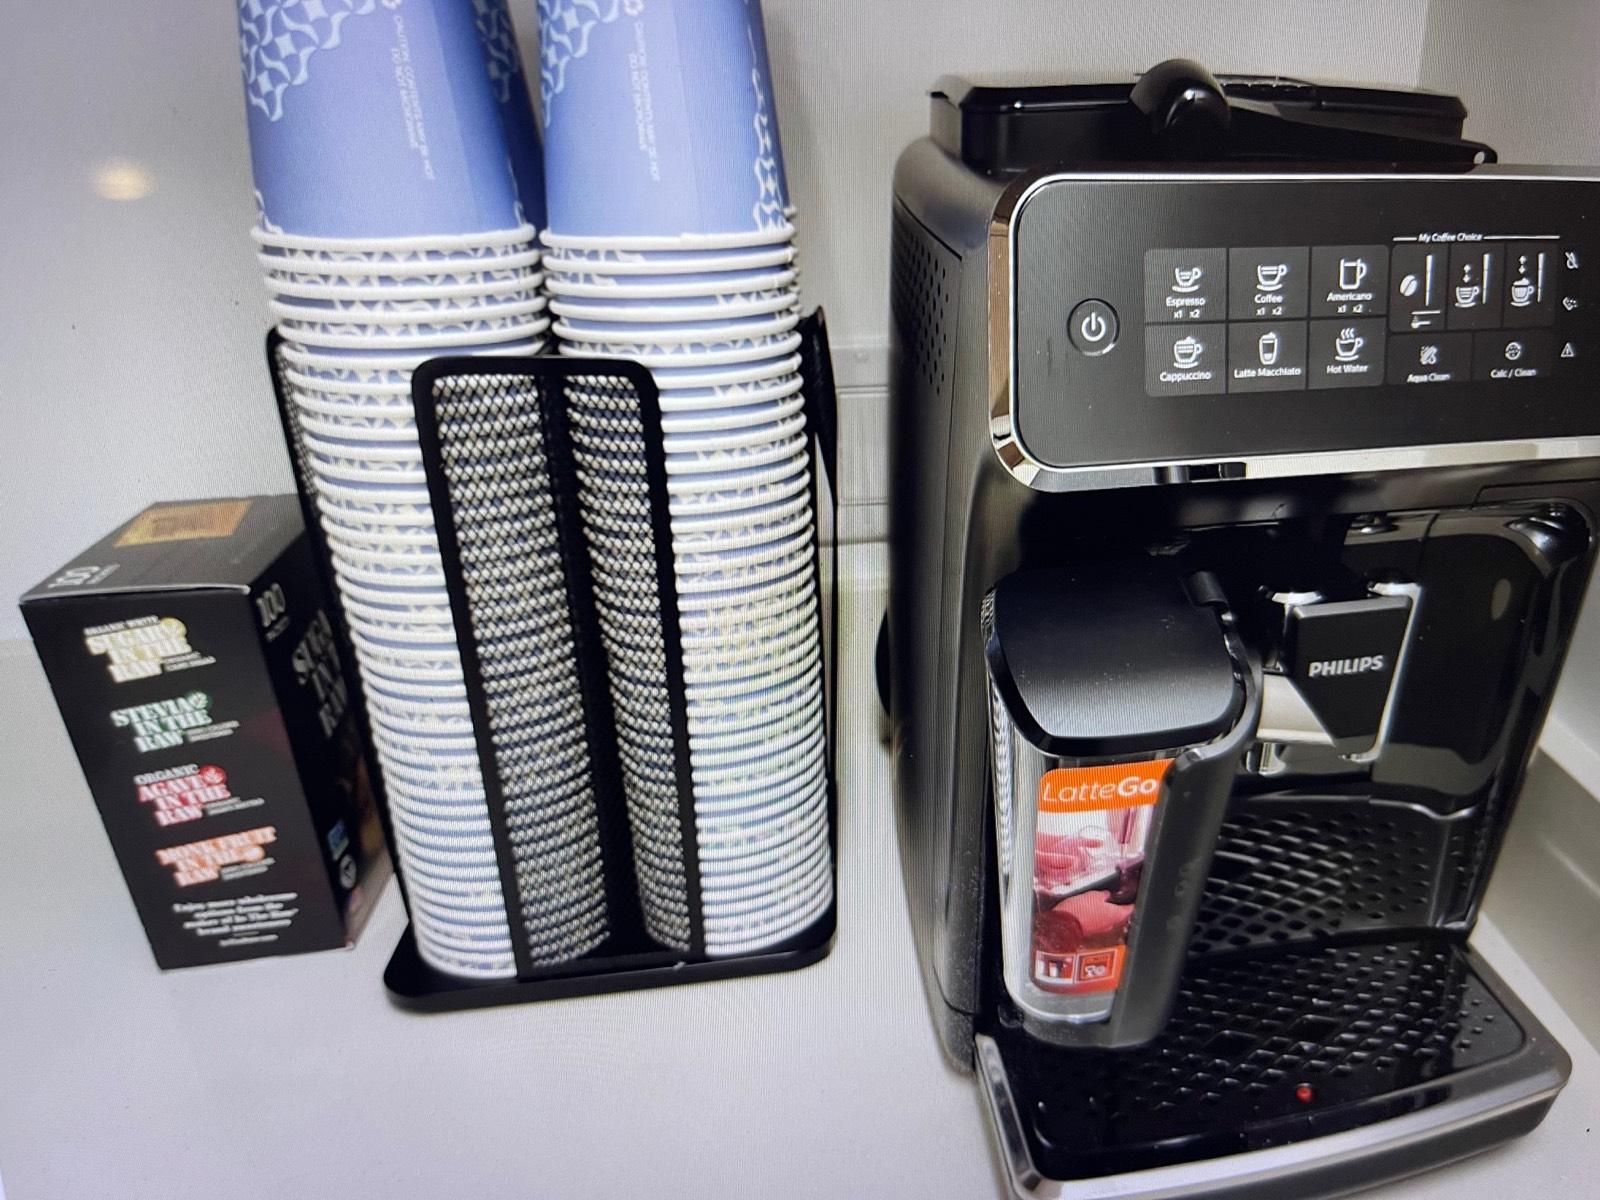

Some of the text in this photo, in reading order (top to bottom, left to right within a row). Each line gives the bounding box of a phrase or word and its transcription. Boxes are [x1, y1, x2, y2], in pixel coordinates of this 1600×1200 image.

[1418, 232, 1483, 244] My Coffee Choice
[1165, 296, 1207, 308] Espresso
[1254, 294, 1284, 304] Coffee
[1327, 292, 1373, 302] Americano
[1173, 309, 1201, 319] x1 x2
[1256, 306, 1283, 316] x1 x2
[1337, 304, 1364, 314] x1 x2
[1234, 367, 1302, 379] Latte Macchiato
[1327, 363, 1369, 374] Hot Water
[1490, 369, 1508, 379] Calc
[1514, 368, 1537, 378] Clean
[1159, 371, 1212, 384] Cappuccino
[1407, 372, 1451, 383] Aqua Clean
[1308, 654, 1384, 677] PHILIPS
[110, 697, 195, 728] STEVIA
[160, 709, 213, 733] THE
[134, 730, 184, 753] RAW
[133, 763, 199, 785] ORGANIC
[1042, 775, 1158, 803] LatteGo
[155, 804, 203, 827] RAW
